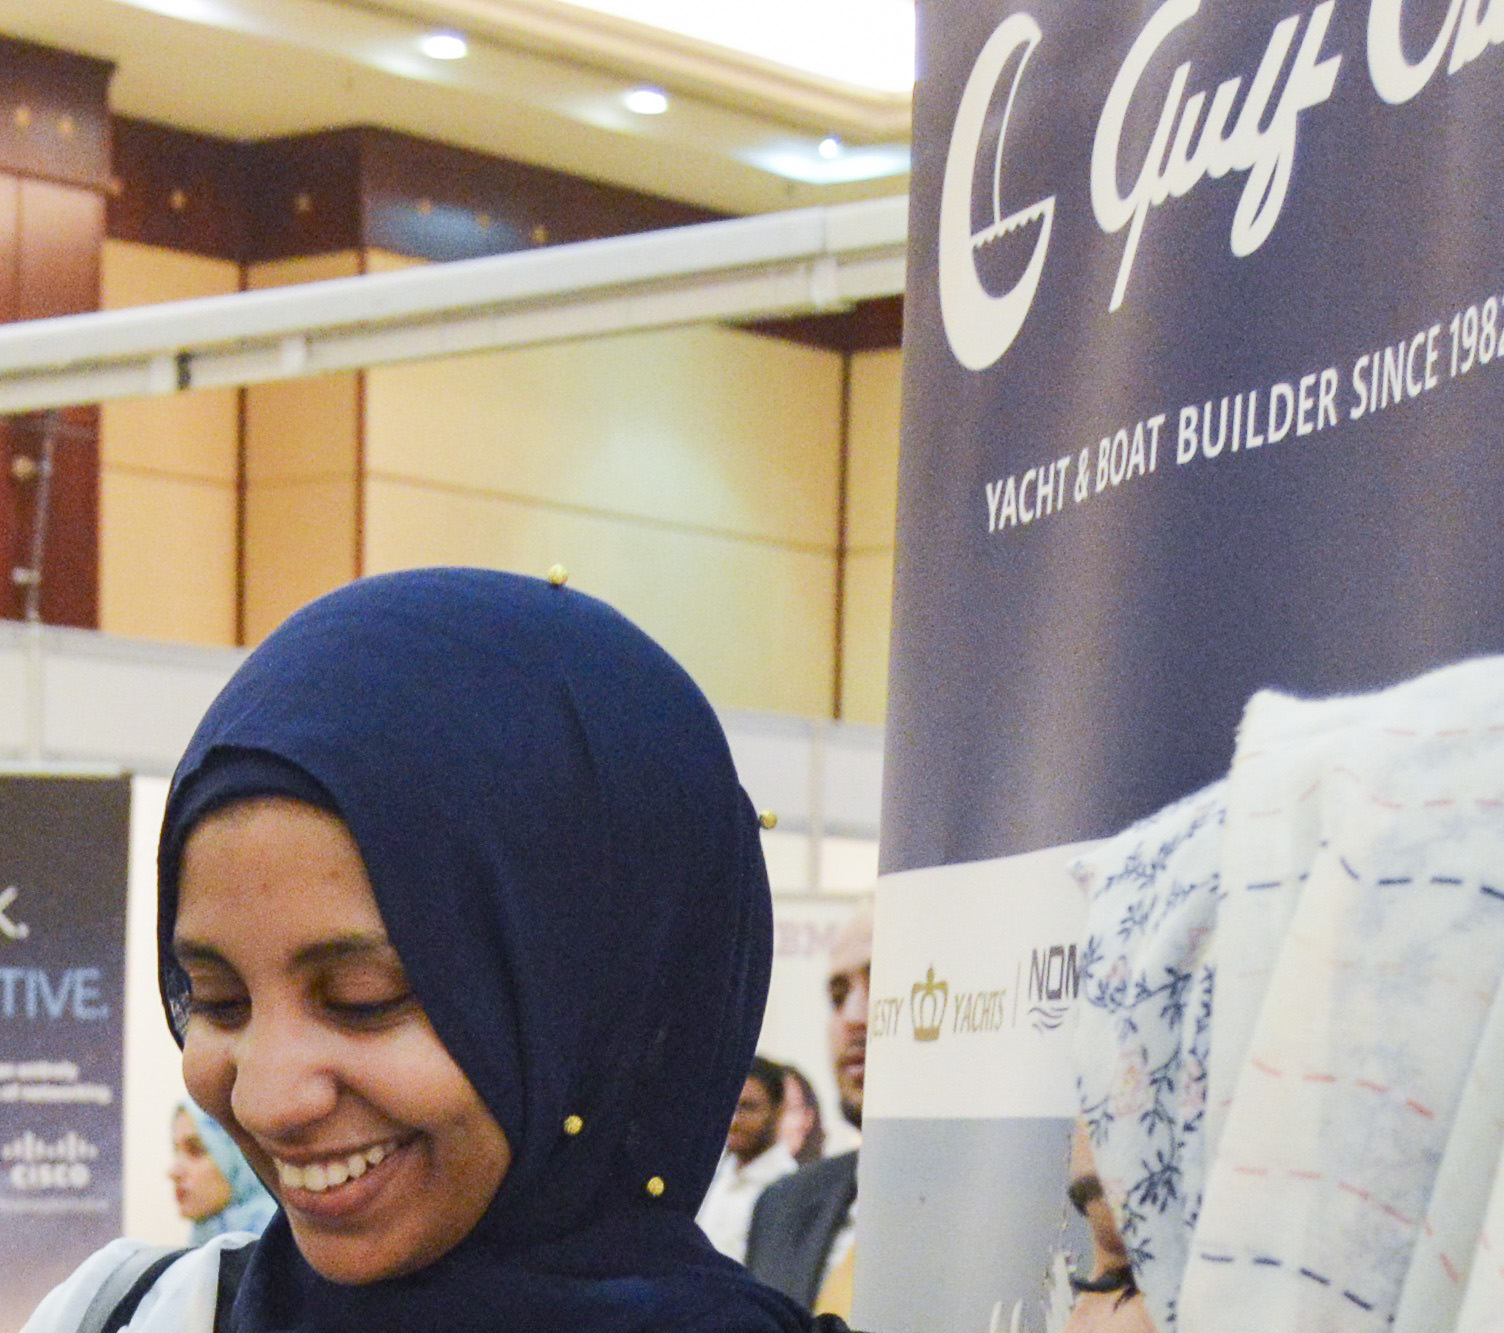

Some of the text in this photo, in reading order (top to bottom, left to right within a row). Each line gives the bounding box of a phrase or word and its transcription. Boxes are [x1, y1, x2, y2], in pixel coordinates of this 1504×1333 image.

[985, 455, 1072, 533] YACHT
[1073, 447, 1090, 502] &
[1095, 412, 1166, 493] BOAT
[1176, 366, 1339, 465] BUILDER
[1350, 324, 1441, 420] SINCE
[953, 988, 1008, 1034] YACHTS
[10, 1162, 91, 1190] CISCO
